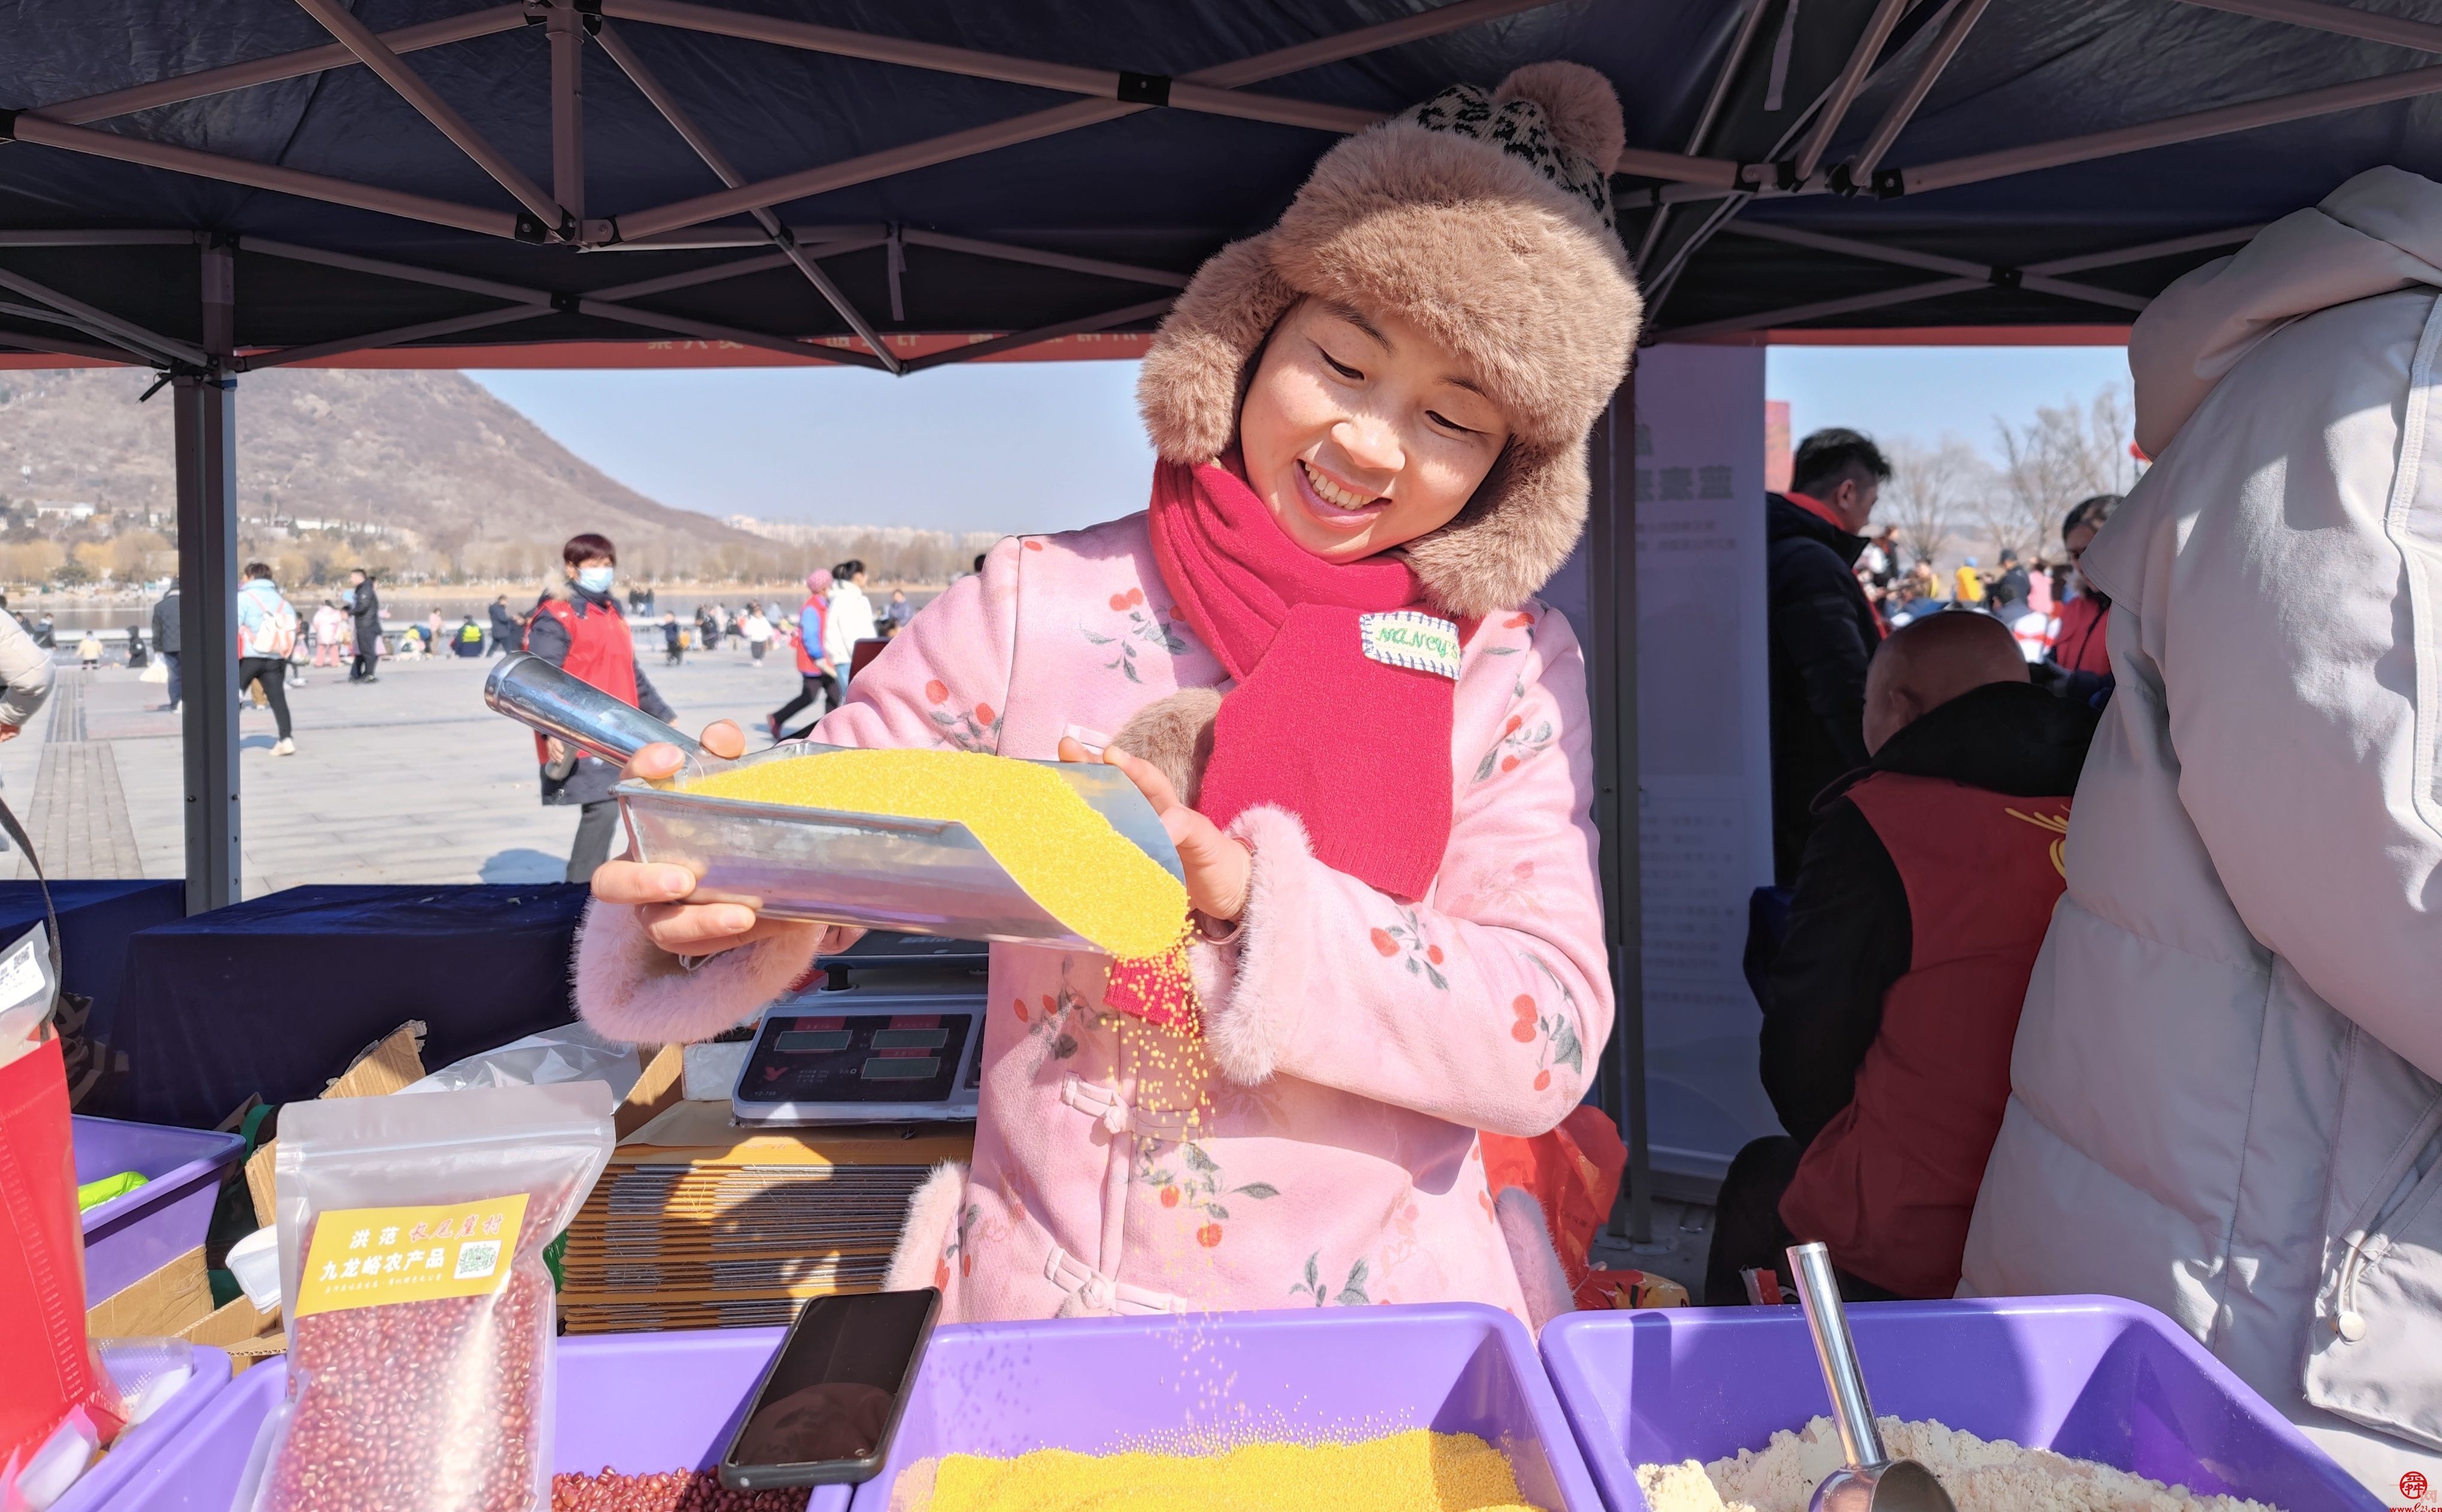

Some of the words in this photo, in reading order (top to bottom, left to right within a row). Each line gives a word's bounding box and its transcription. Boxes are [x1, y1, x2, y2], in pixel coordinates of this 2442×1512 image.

[349, 1226, 399, 1249] 洪范
[318, 1247, 445, 1282] 九龙峪农产品
